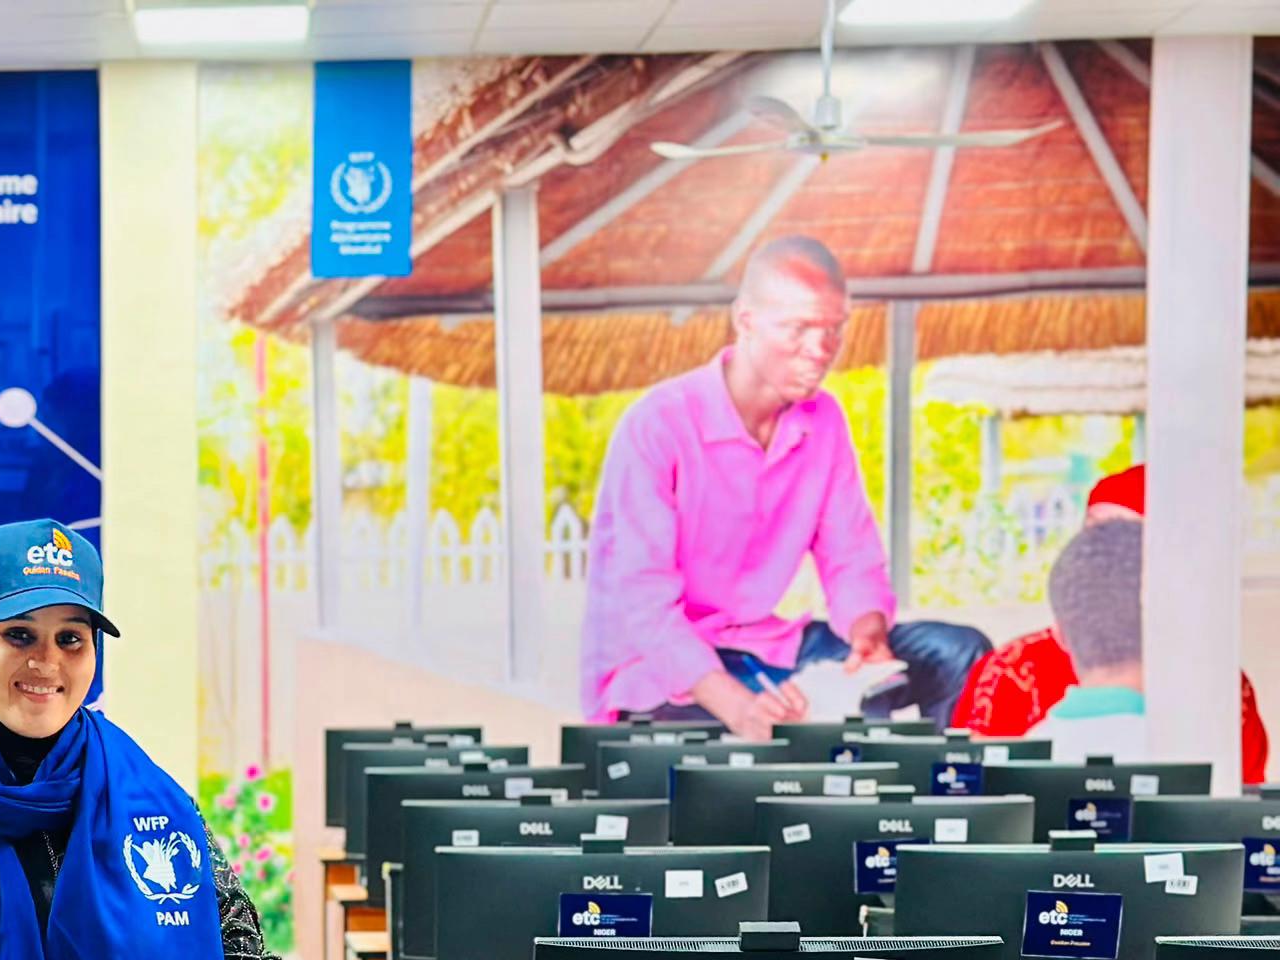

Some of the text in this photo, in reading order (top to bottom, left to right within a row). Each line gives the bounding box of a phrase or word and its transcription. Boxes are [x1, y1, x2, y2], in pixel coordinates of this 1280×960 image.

[27, 542, 73, 567] etc
[133, 815, 169, 832] WFP
[520, 822, 553, 835] DELL
[878, 819, 913, 833] DELL
[583, 876, 623, 890] DELL
[1053, 873, 1095, 888] DELL
[156, 911, 190, 926] PAM
[572, 911, 600, 926] etc
[1038, 909, 1068, 925] etc
